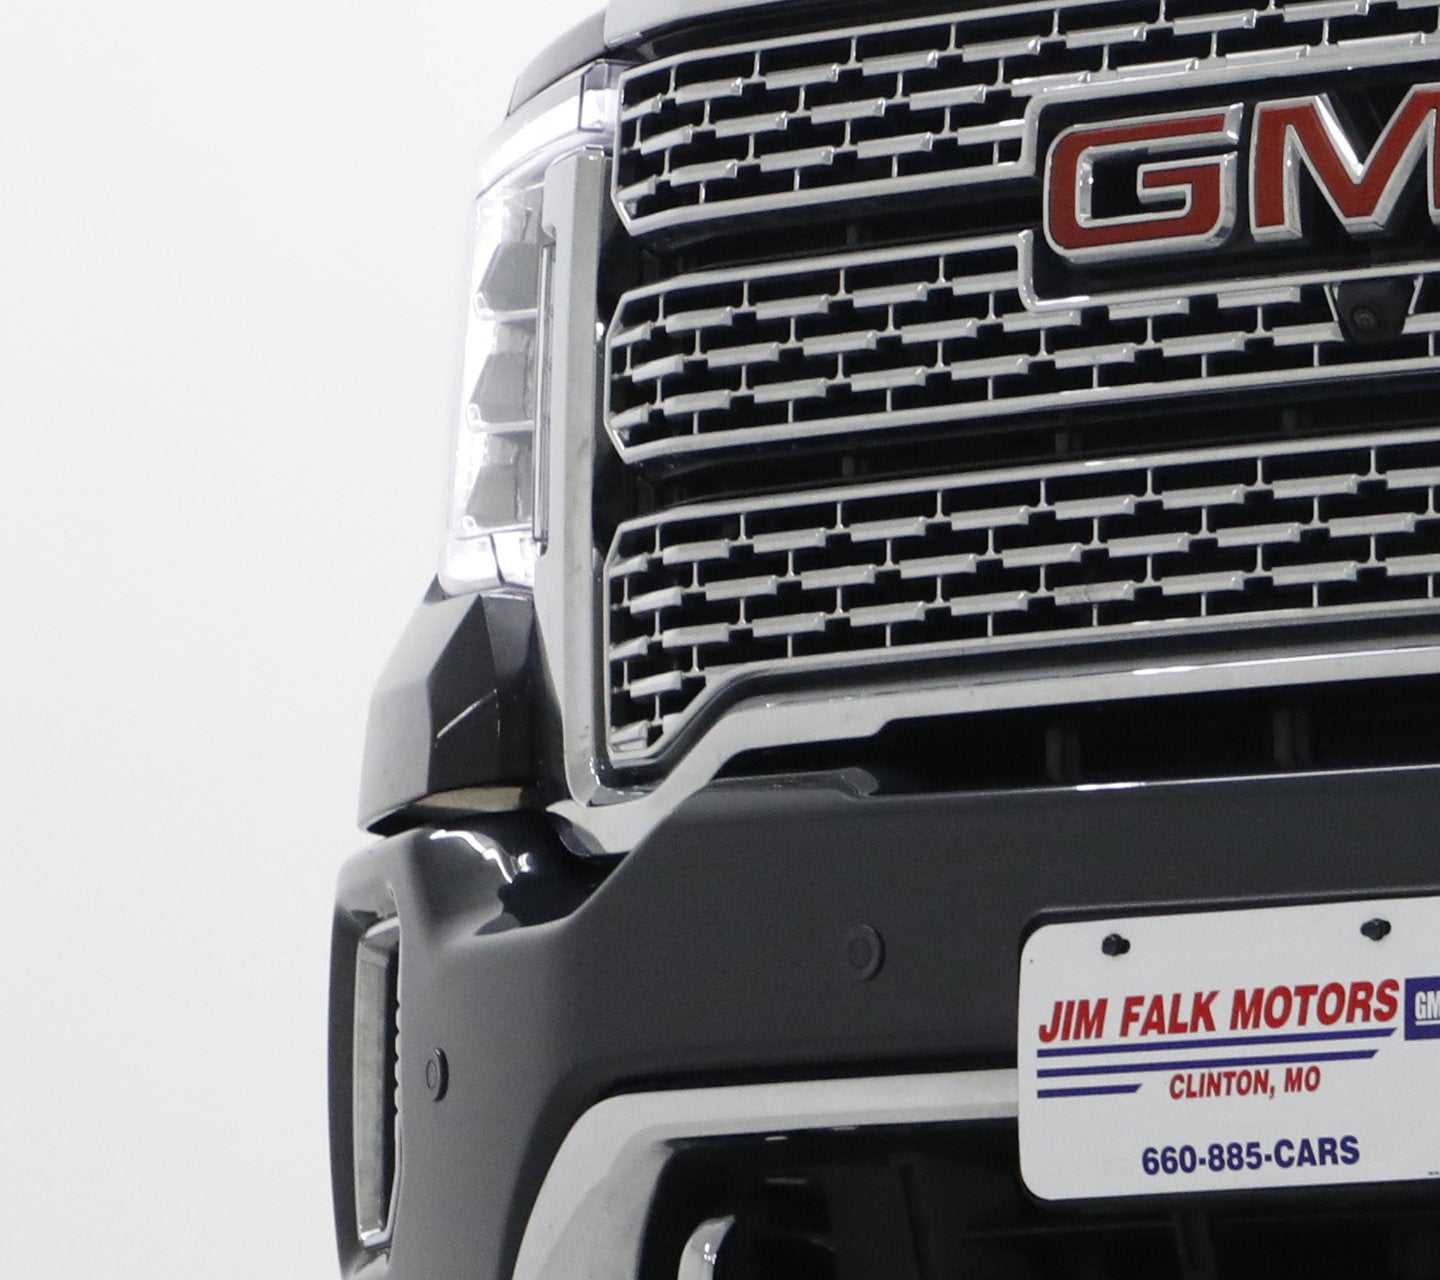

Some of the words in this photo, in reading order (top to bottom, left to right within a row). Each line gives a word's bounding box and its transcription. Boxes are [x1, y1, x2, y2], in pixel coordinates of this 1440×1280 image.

[1037, 997, 1108, 1043] JIM
[1118, 990, 1220, 1037] FALK
[1228, 978, 1401, 1031] MOTORS
[1168, 1069, 1276, 1100] CLINTON,
[1283, 1065, 1322, 1093] MO
[1141, 1135, 1361, 1176] 660-885-CARS
